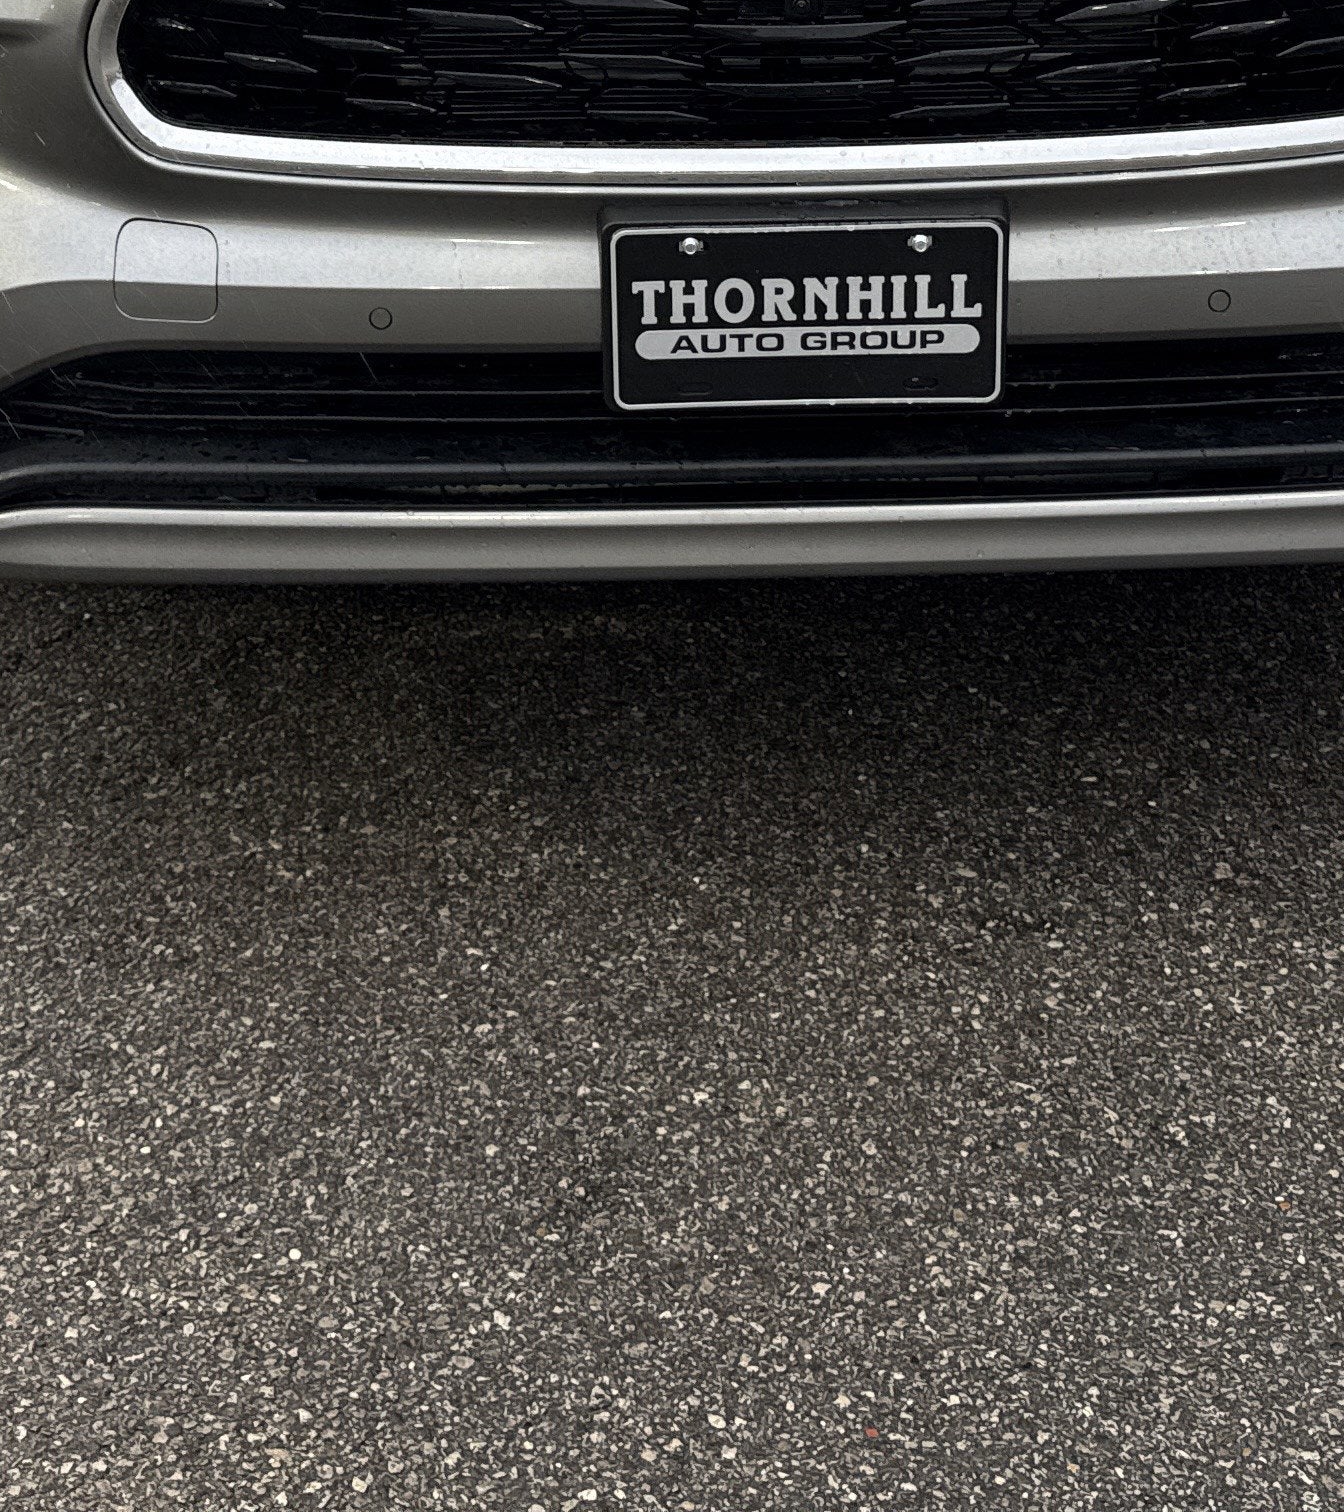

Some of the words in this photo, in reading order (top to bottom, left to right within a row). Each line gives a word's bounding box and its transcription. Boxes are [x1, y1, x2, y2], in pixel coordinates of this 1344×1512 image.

[631, 274, 982, 325] THORNHILL
[670, 332, 784, 354] AUTO
[800, 329, 945, 351] GROUP
